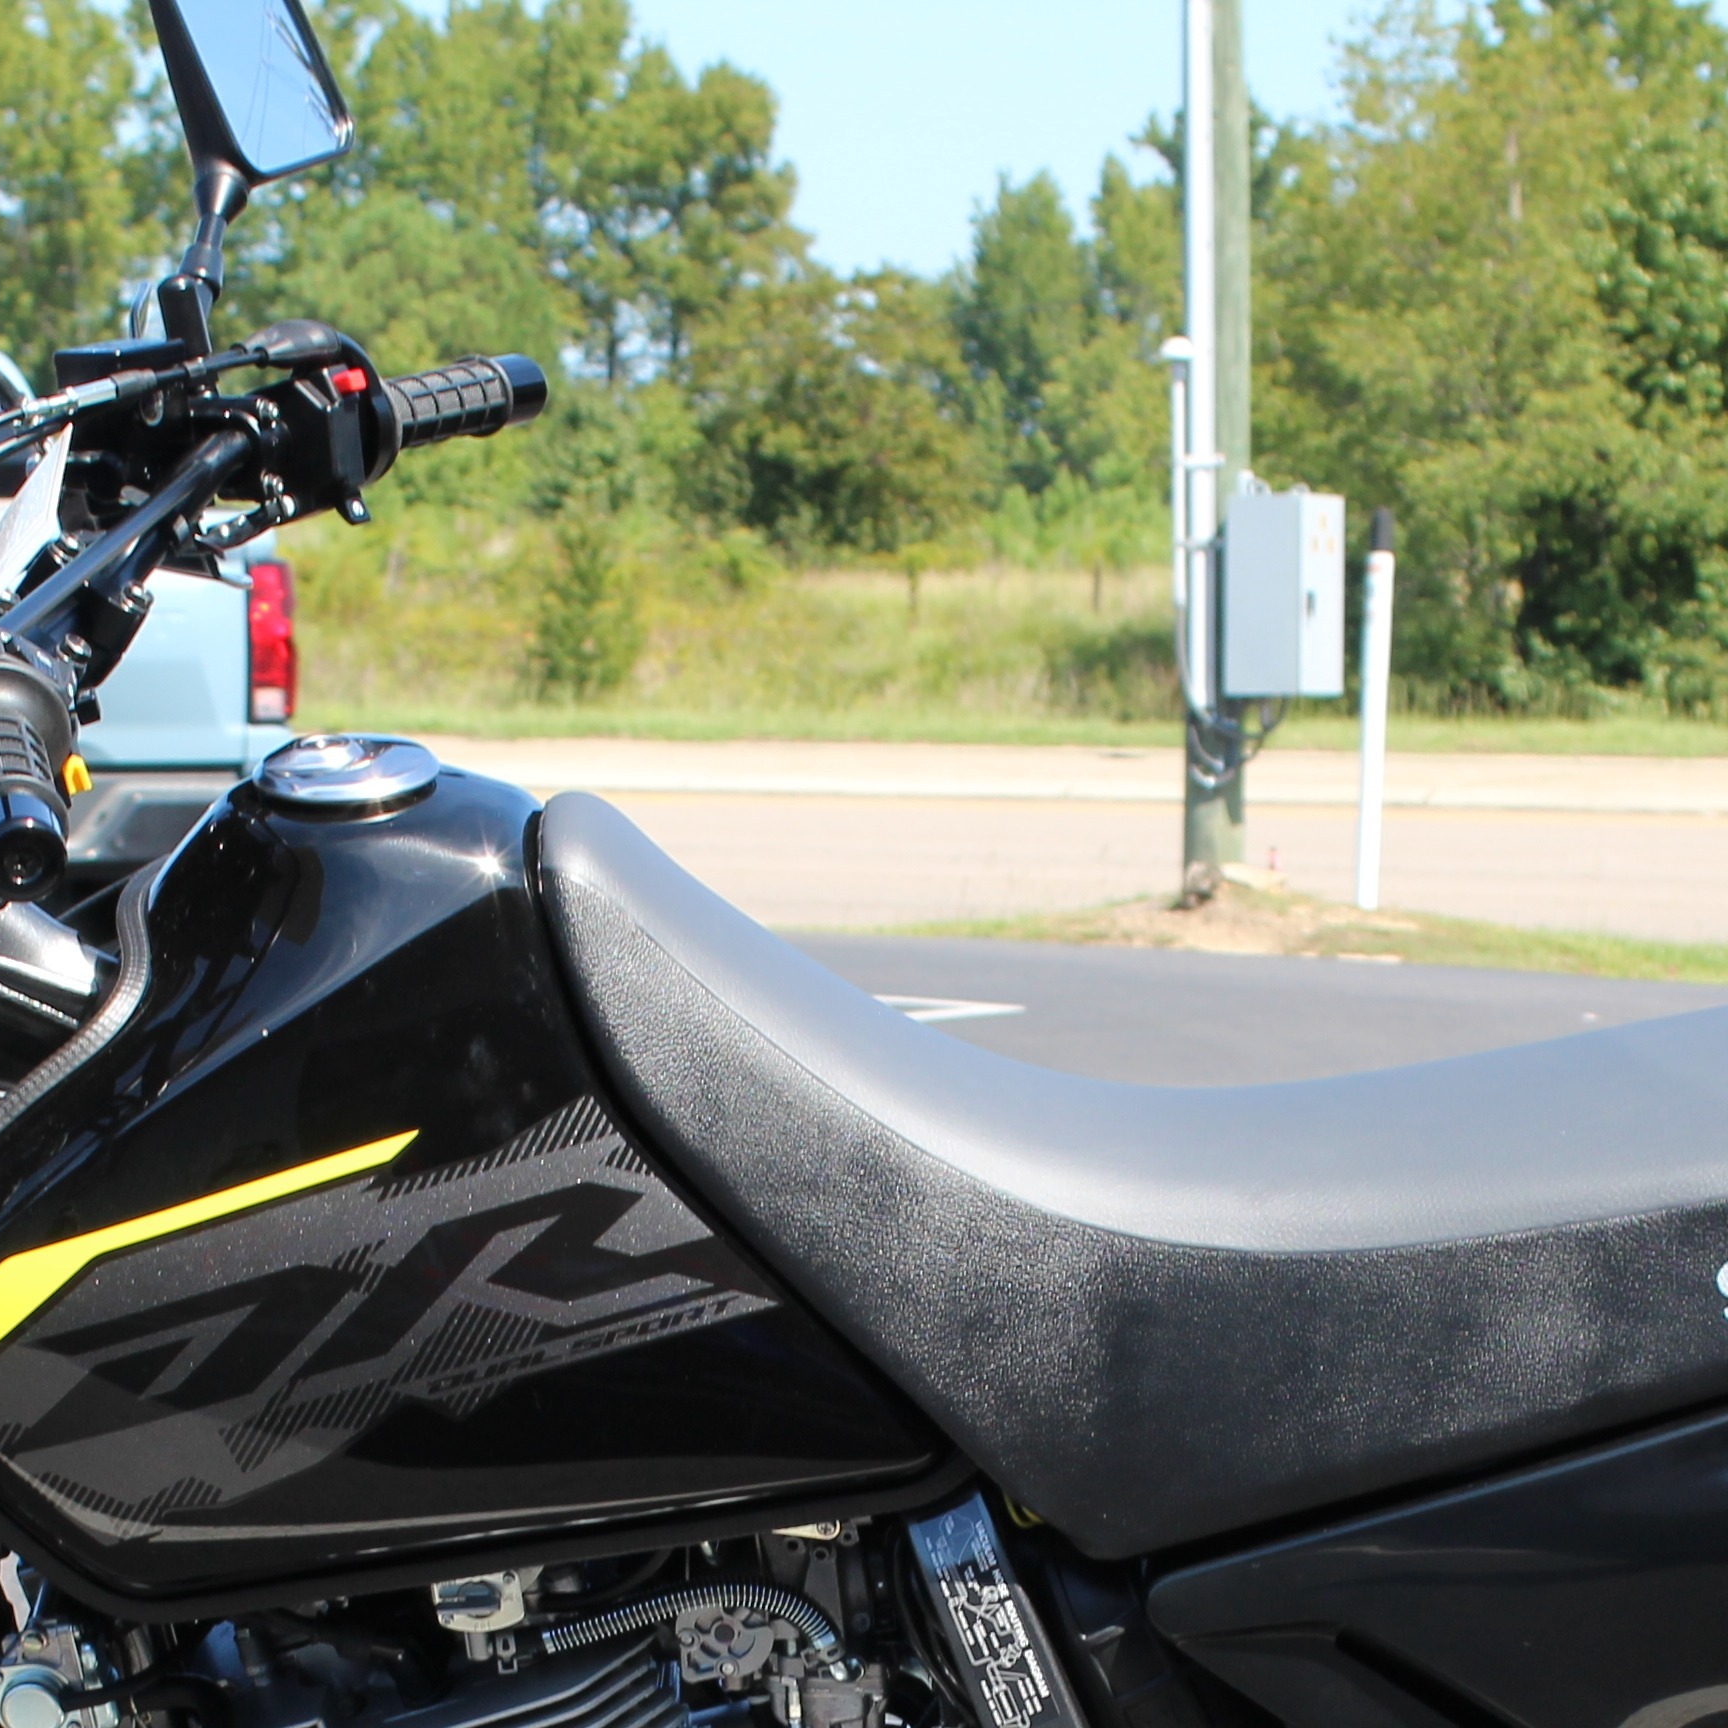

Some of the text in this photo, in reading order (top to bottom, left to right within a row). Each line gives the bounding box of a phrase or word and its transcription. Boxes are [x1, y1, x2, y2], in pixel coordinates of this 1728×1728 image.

[427, 1294, 740, 1395] DUAL SPORT
[975, 1520, 1050, 1699] VACUUM HOSE ROUTING DIAGRAM
